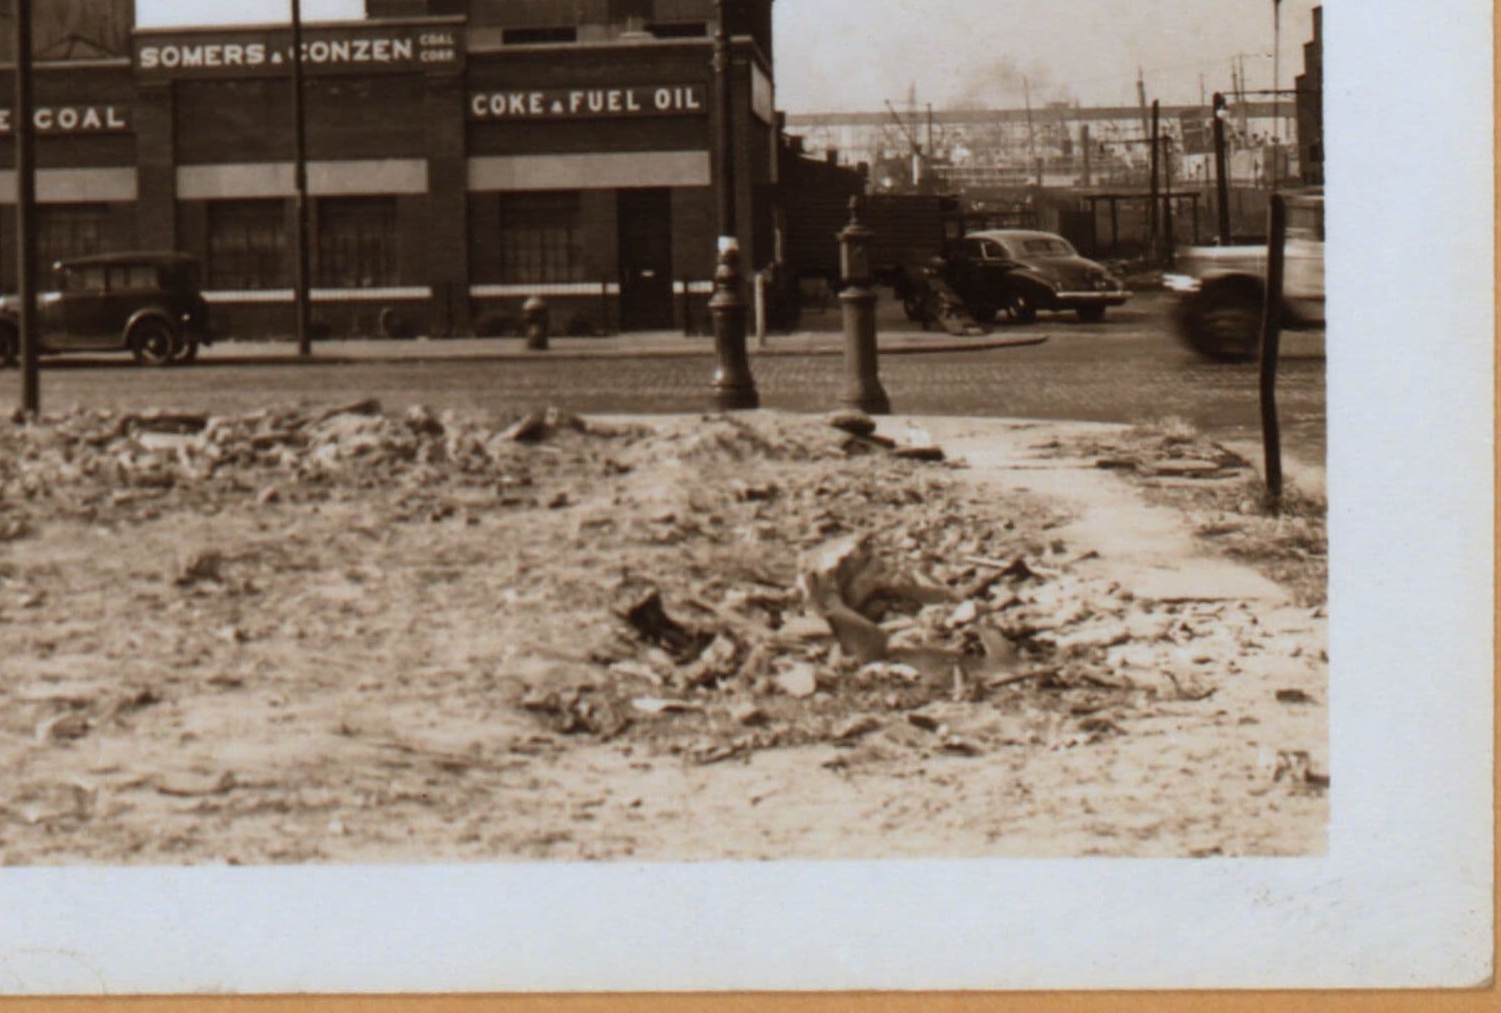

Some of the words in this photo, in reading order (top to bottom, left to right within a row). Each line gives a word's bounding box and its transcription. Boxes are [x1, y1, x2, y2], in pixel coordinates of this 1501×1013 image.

[419, 33, 454, 46] COAL
[139, 44, 265, 68] SOMERS
[471, 91, 545, 115] COKE
[568, 89, 642, 113] FUEL
[653, 87, 701, 110] OIL
[33, 106, 126, 130] COAL
